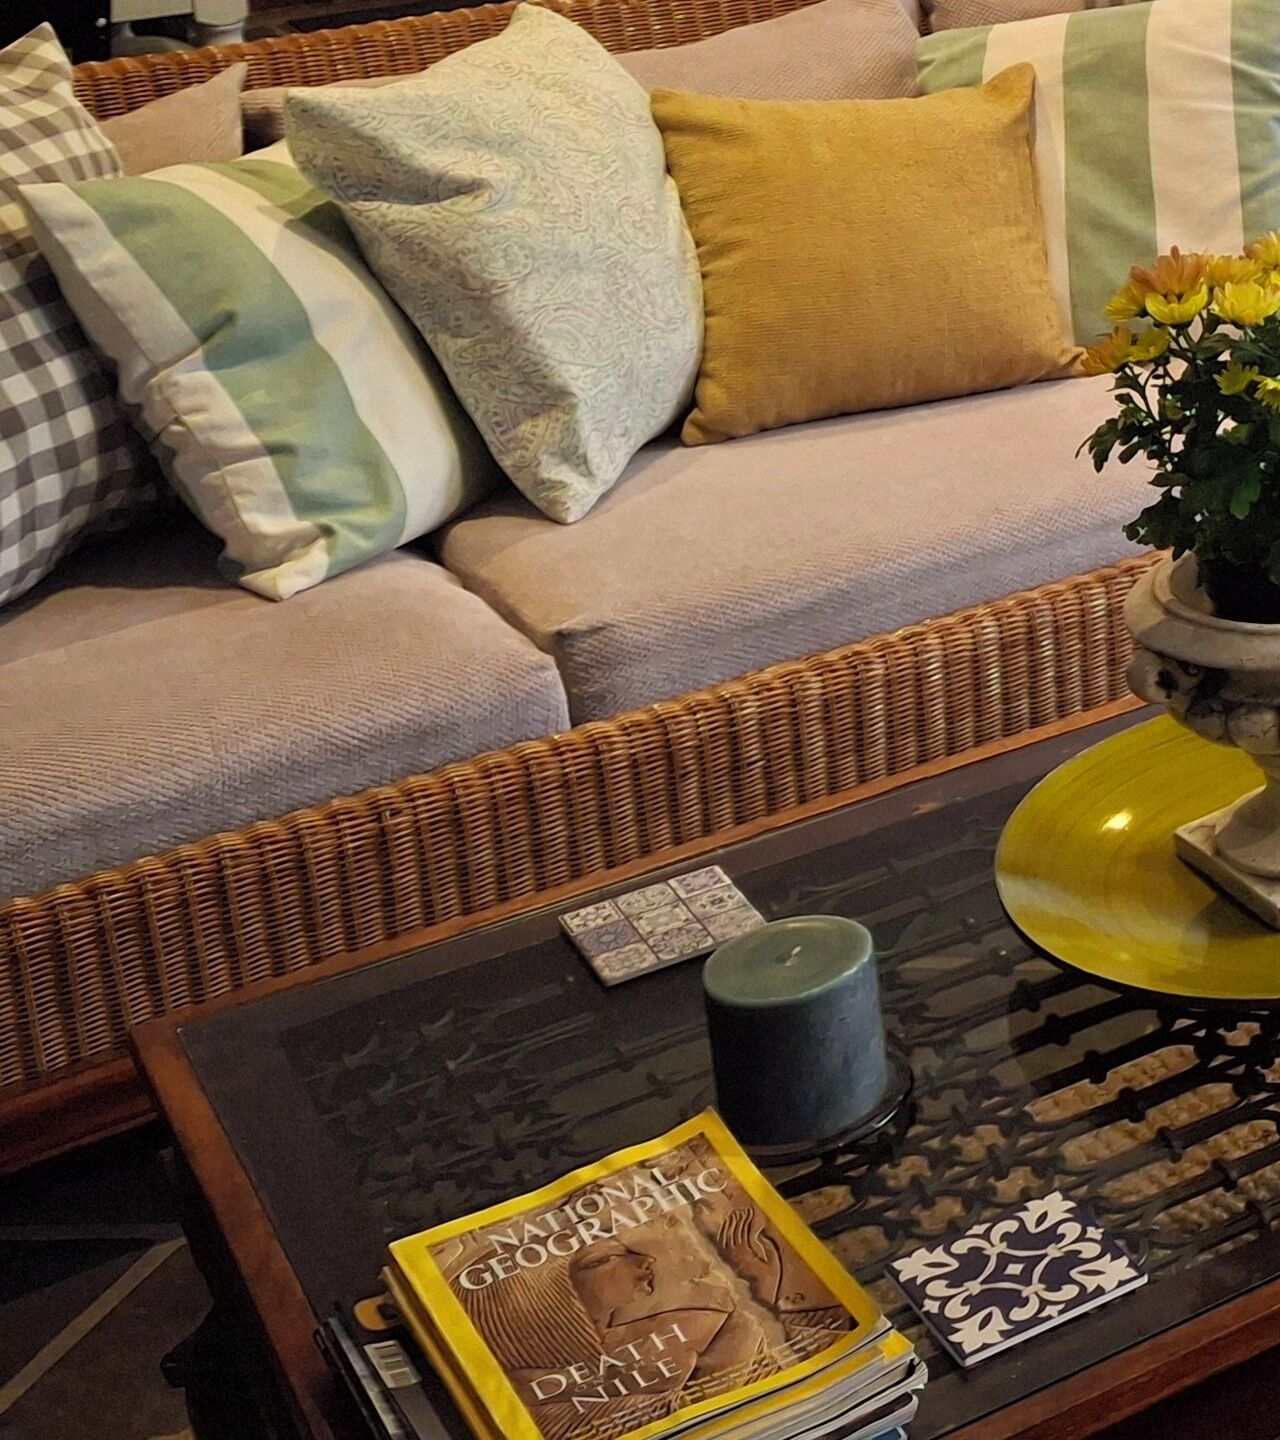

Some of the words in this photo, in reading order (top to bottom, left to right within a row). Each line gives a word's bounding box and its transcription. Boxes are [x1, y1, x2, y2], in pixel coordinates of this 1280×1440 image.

[458, 1166, 729, 1291] GEOGRAPHIC
[488, 1165, 680, 1253] NATIONAL
[528, 1322, 690, 1401] DEATH
[570, 1356, 684, 1415] NILE
